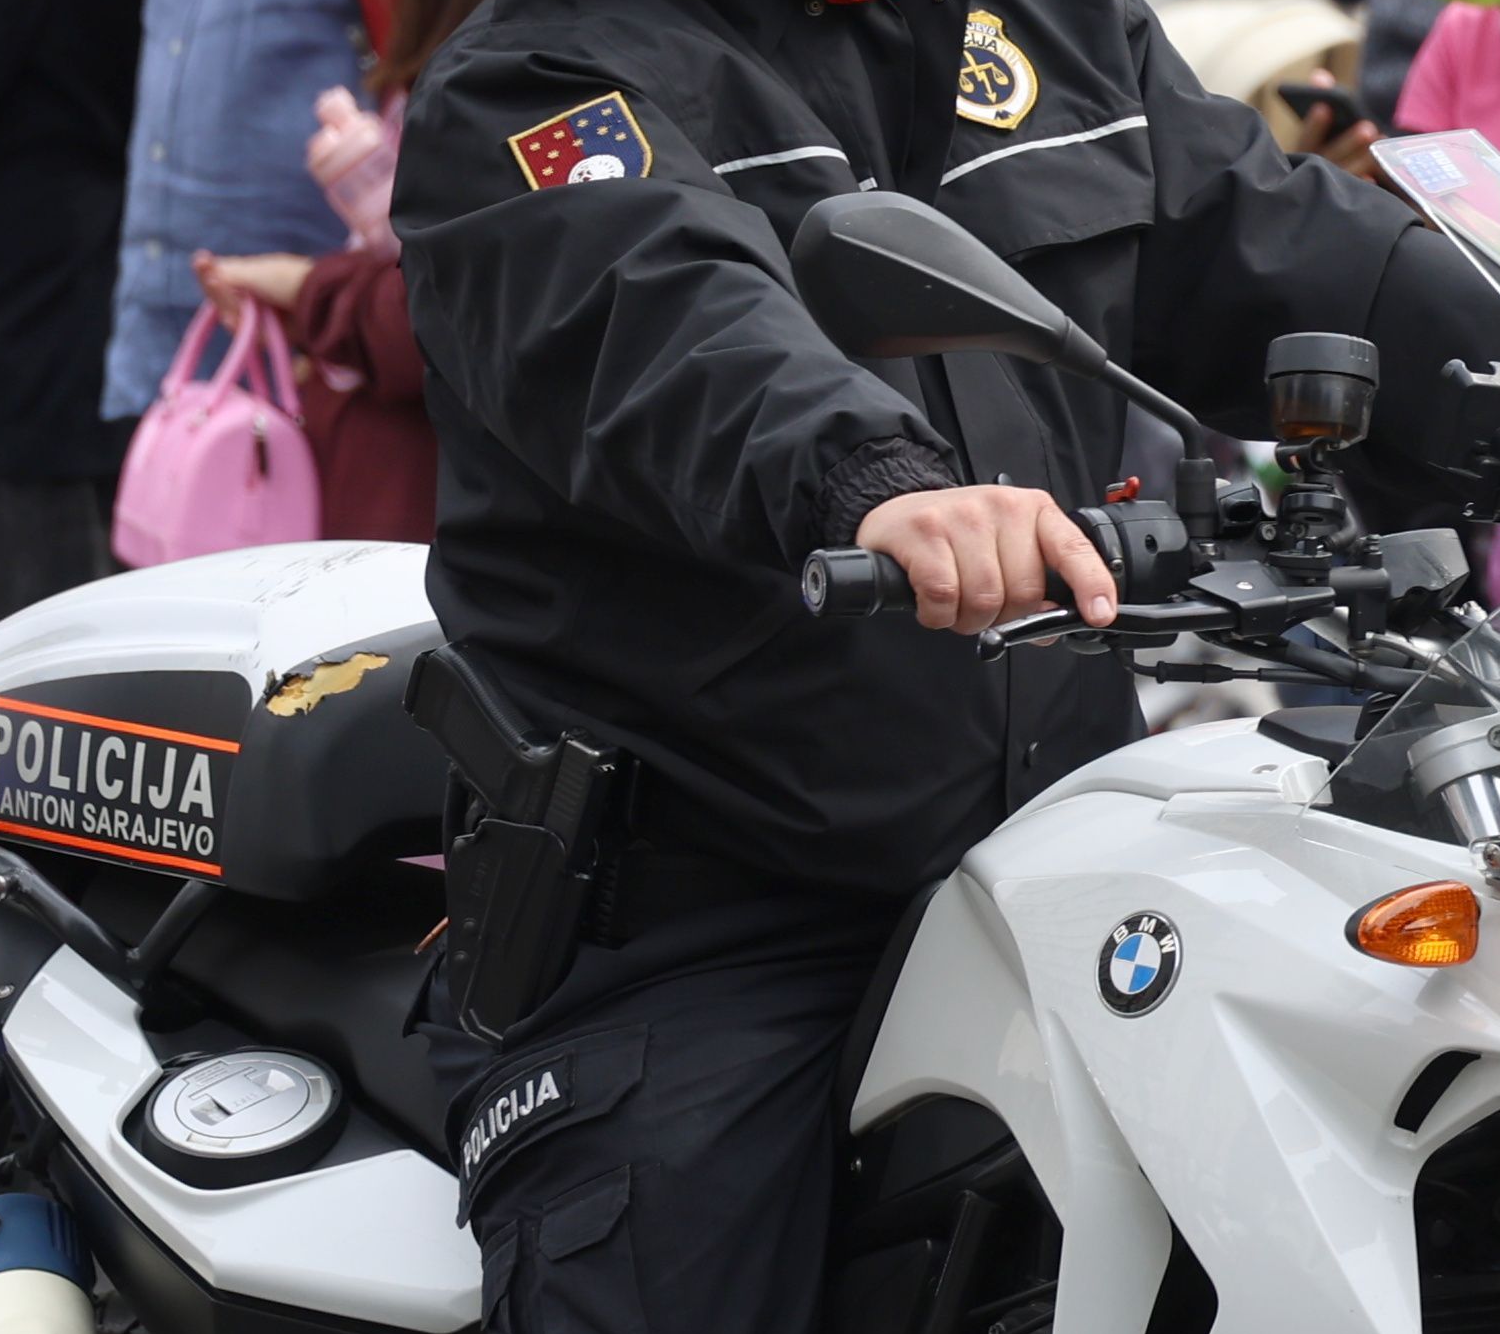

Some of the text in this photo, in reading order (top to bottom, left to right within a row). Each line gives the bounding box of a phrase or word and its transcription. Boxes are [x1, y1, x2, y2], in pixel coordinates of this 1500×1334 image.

[82, 802, 214, 856] SARAJEVO
[1112, 916, 1176, 954] BMW
[463, 1071, 560, 1180] POLICIJA
